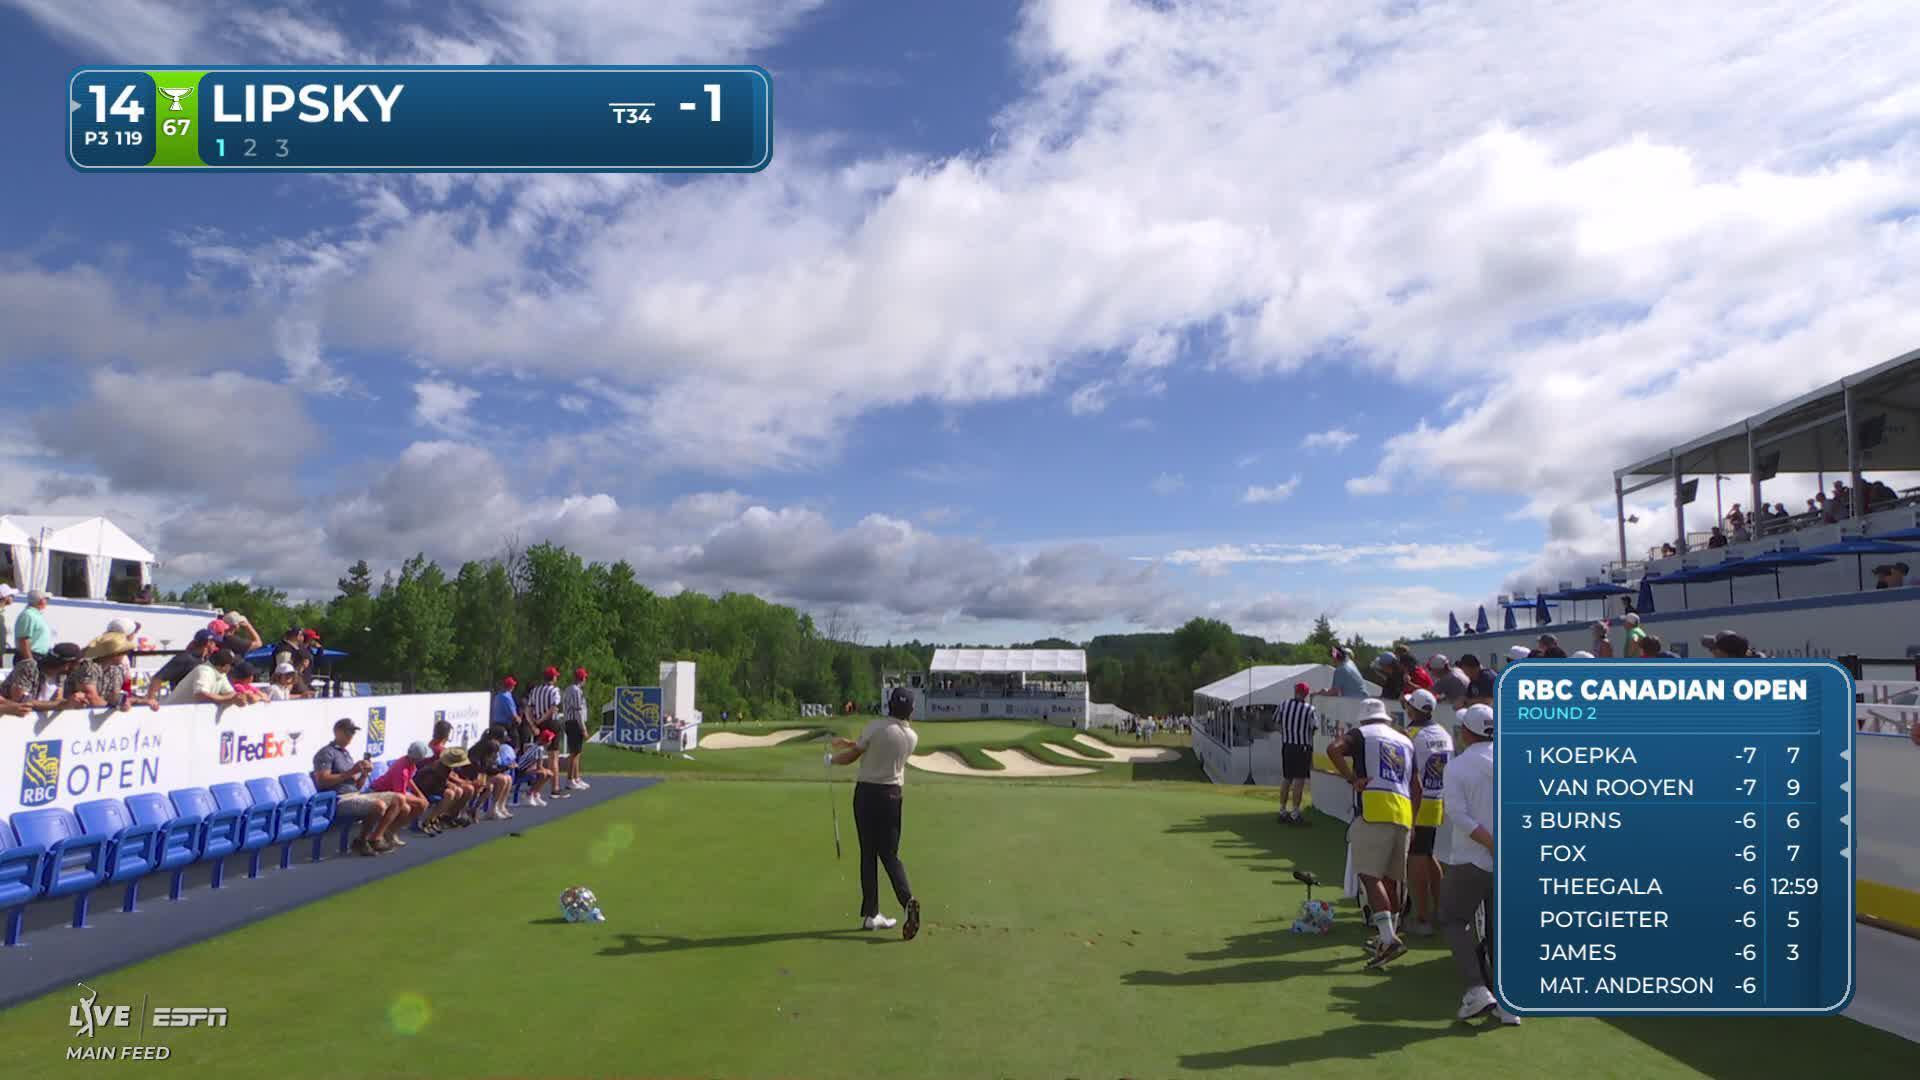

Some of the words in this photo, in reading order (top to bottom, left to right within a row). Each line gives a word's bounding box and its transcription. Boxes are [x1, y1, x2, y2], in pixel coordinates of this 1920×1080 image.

[71, 728, 163, 756] CANADIAN
[236, 732, 285, 763] FedEx
[620, 727, 659, 742] RBC
[66, 756, 160, 796] OPEN
[23, 785, 56, 804] RBC
